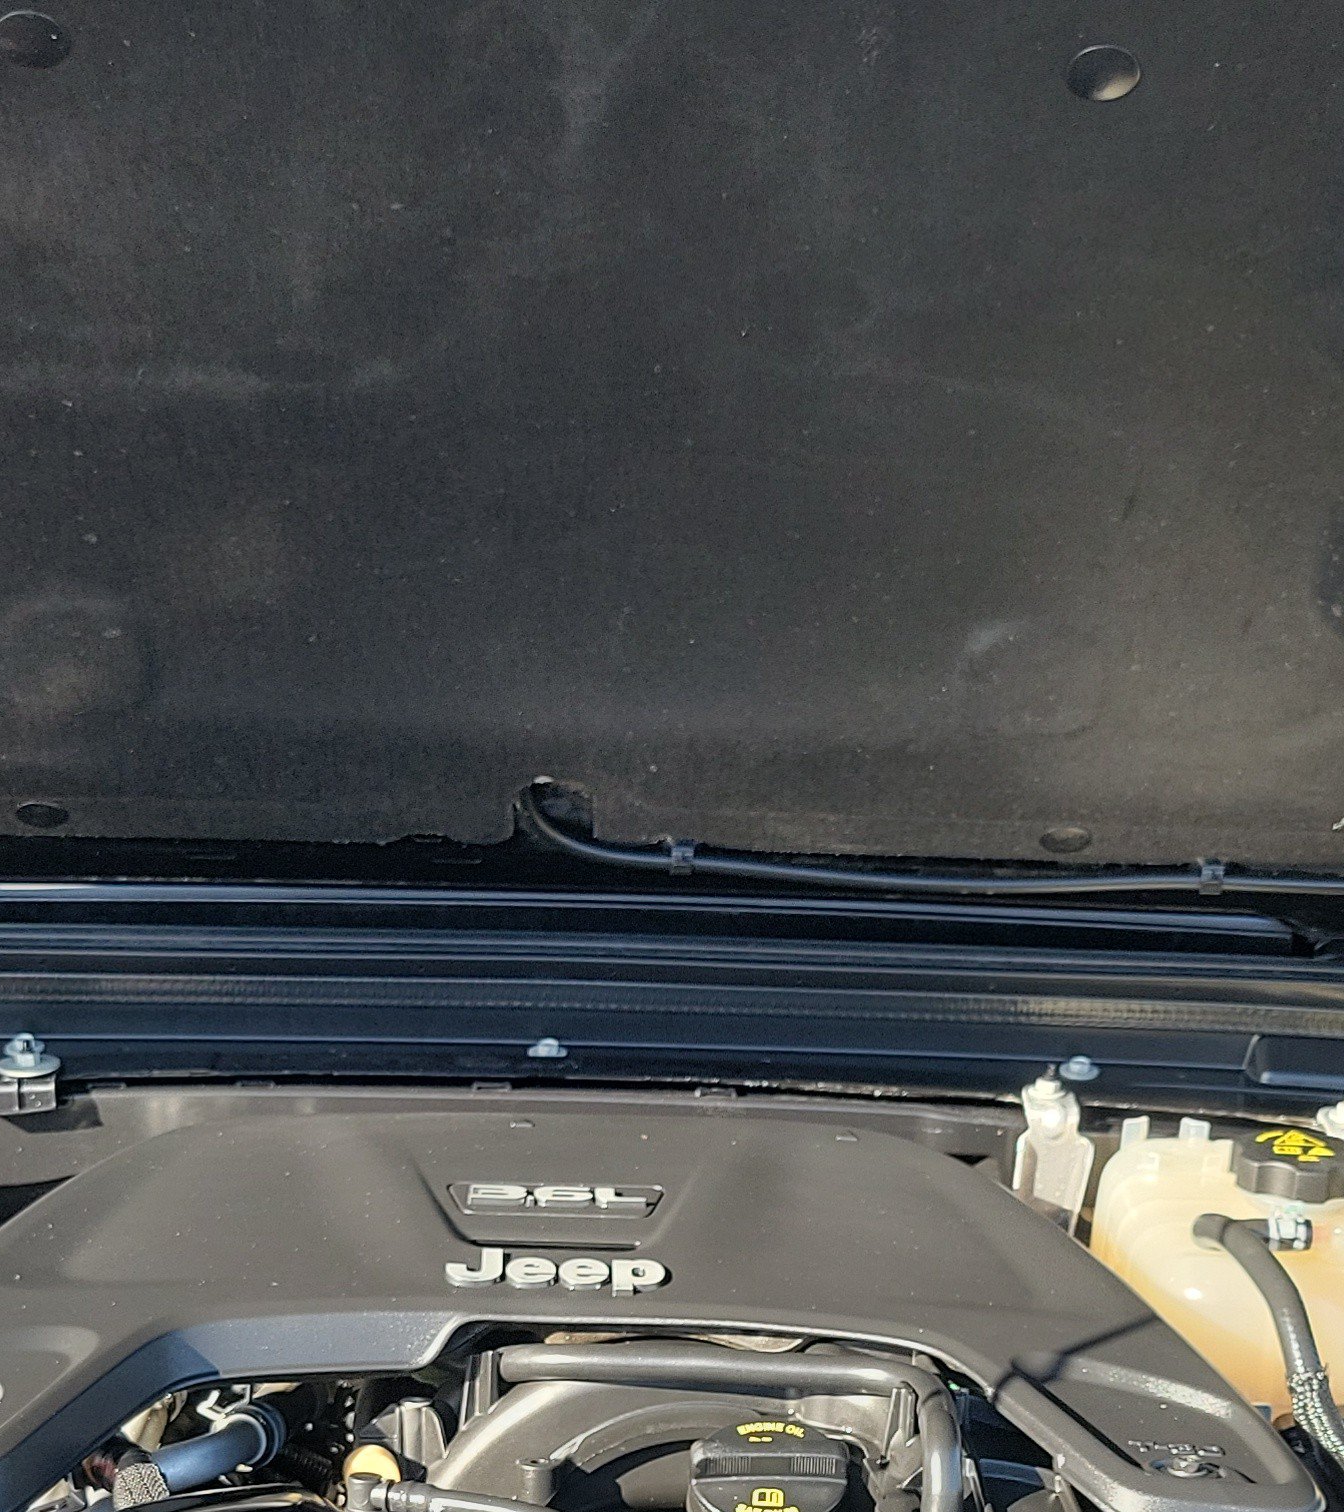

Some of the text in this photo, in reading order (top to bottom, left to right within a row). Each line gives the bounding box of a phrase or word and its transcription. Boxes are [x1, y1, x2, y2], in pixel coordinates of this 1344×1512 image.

[444, 1247, 667, 1297] Jeep
[736, 1421, 806, 1439] ENGINE OIL
